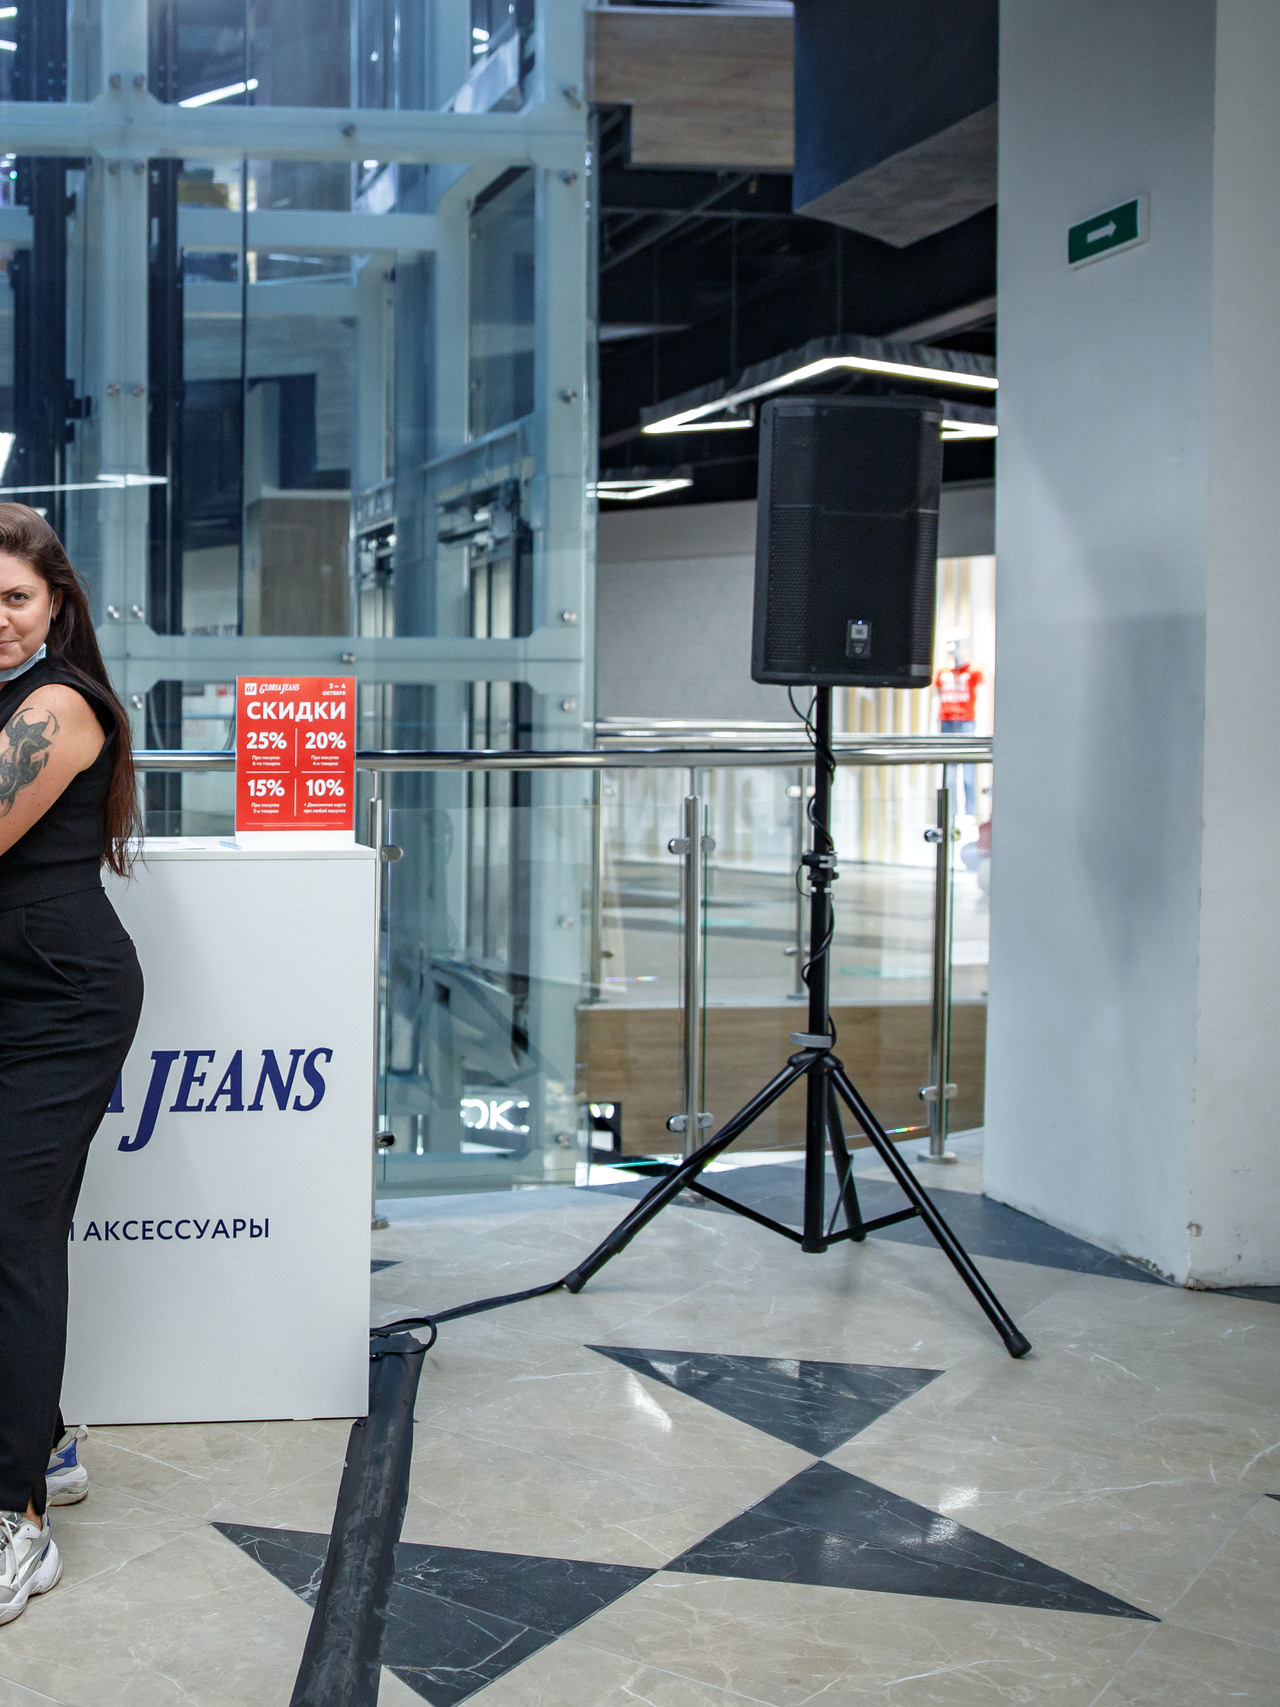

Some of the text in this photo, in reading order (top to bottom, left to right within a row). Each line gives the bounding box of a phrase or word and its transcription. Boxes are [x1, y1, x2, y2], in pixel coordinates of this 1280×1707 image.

[259, 684, 281, 694] GLORIA
[279, 684, 300, 694] JEANS
[246, 701, 346, 722] СКИДКИ
[246, 731, 288, 750] 25%
[304, 731, 347, 750] 20%
[247, 778, 286, 797] 15%
[305, 778, 345, 797] 10%
[117, 1047, 334, 1153] JEANS
[82, 1218, 270, 1243] АКСЕССУАРЫ
